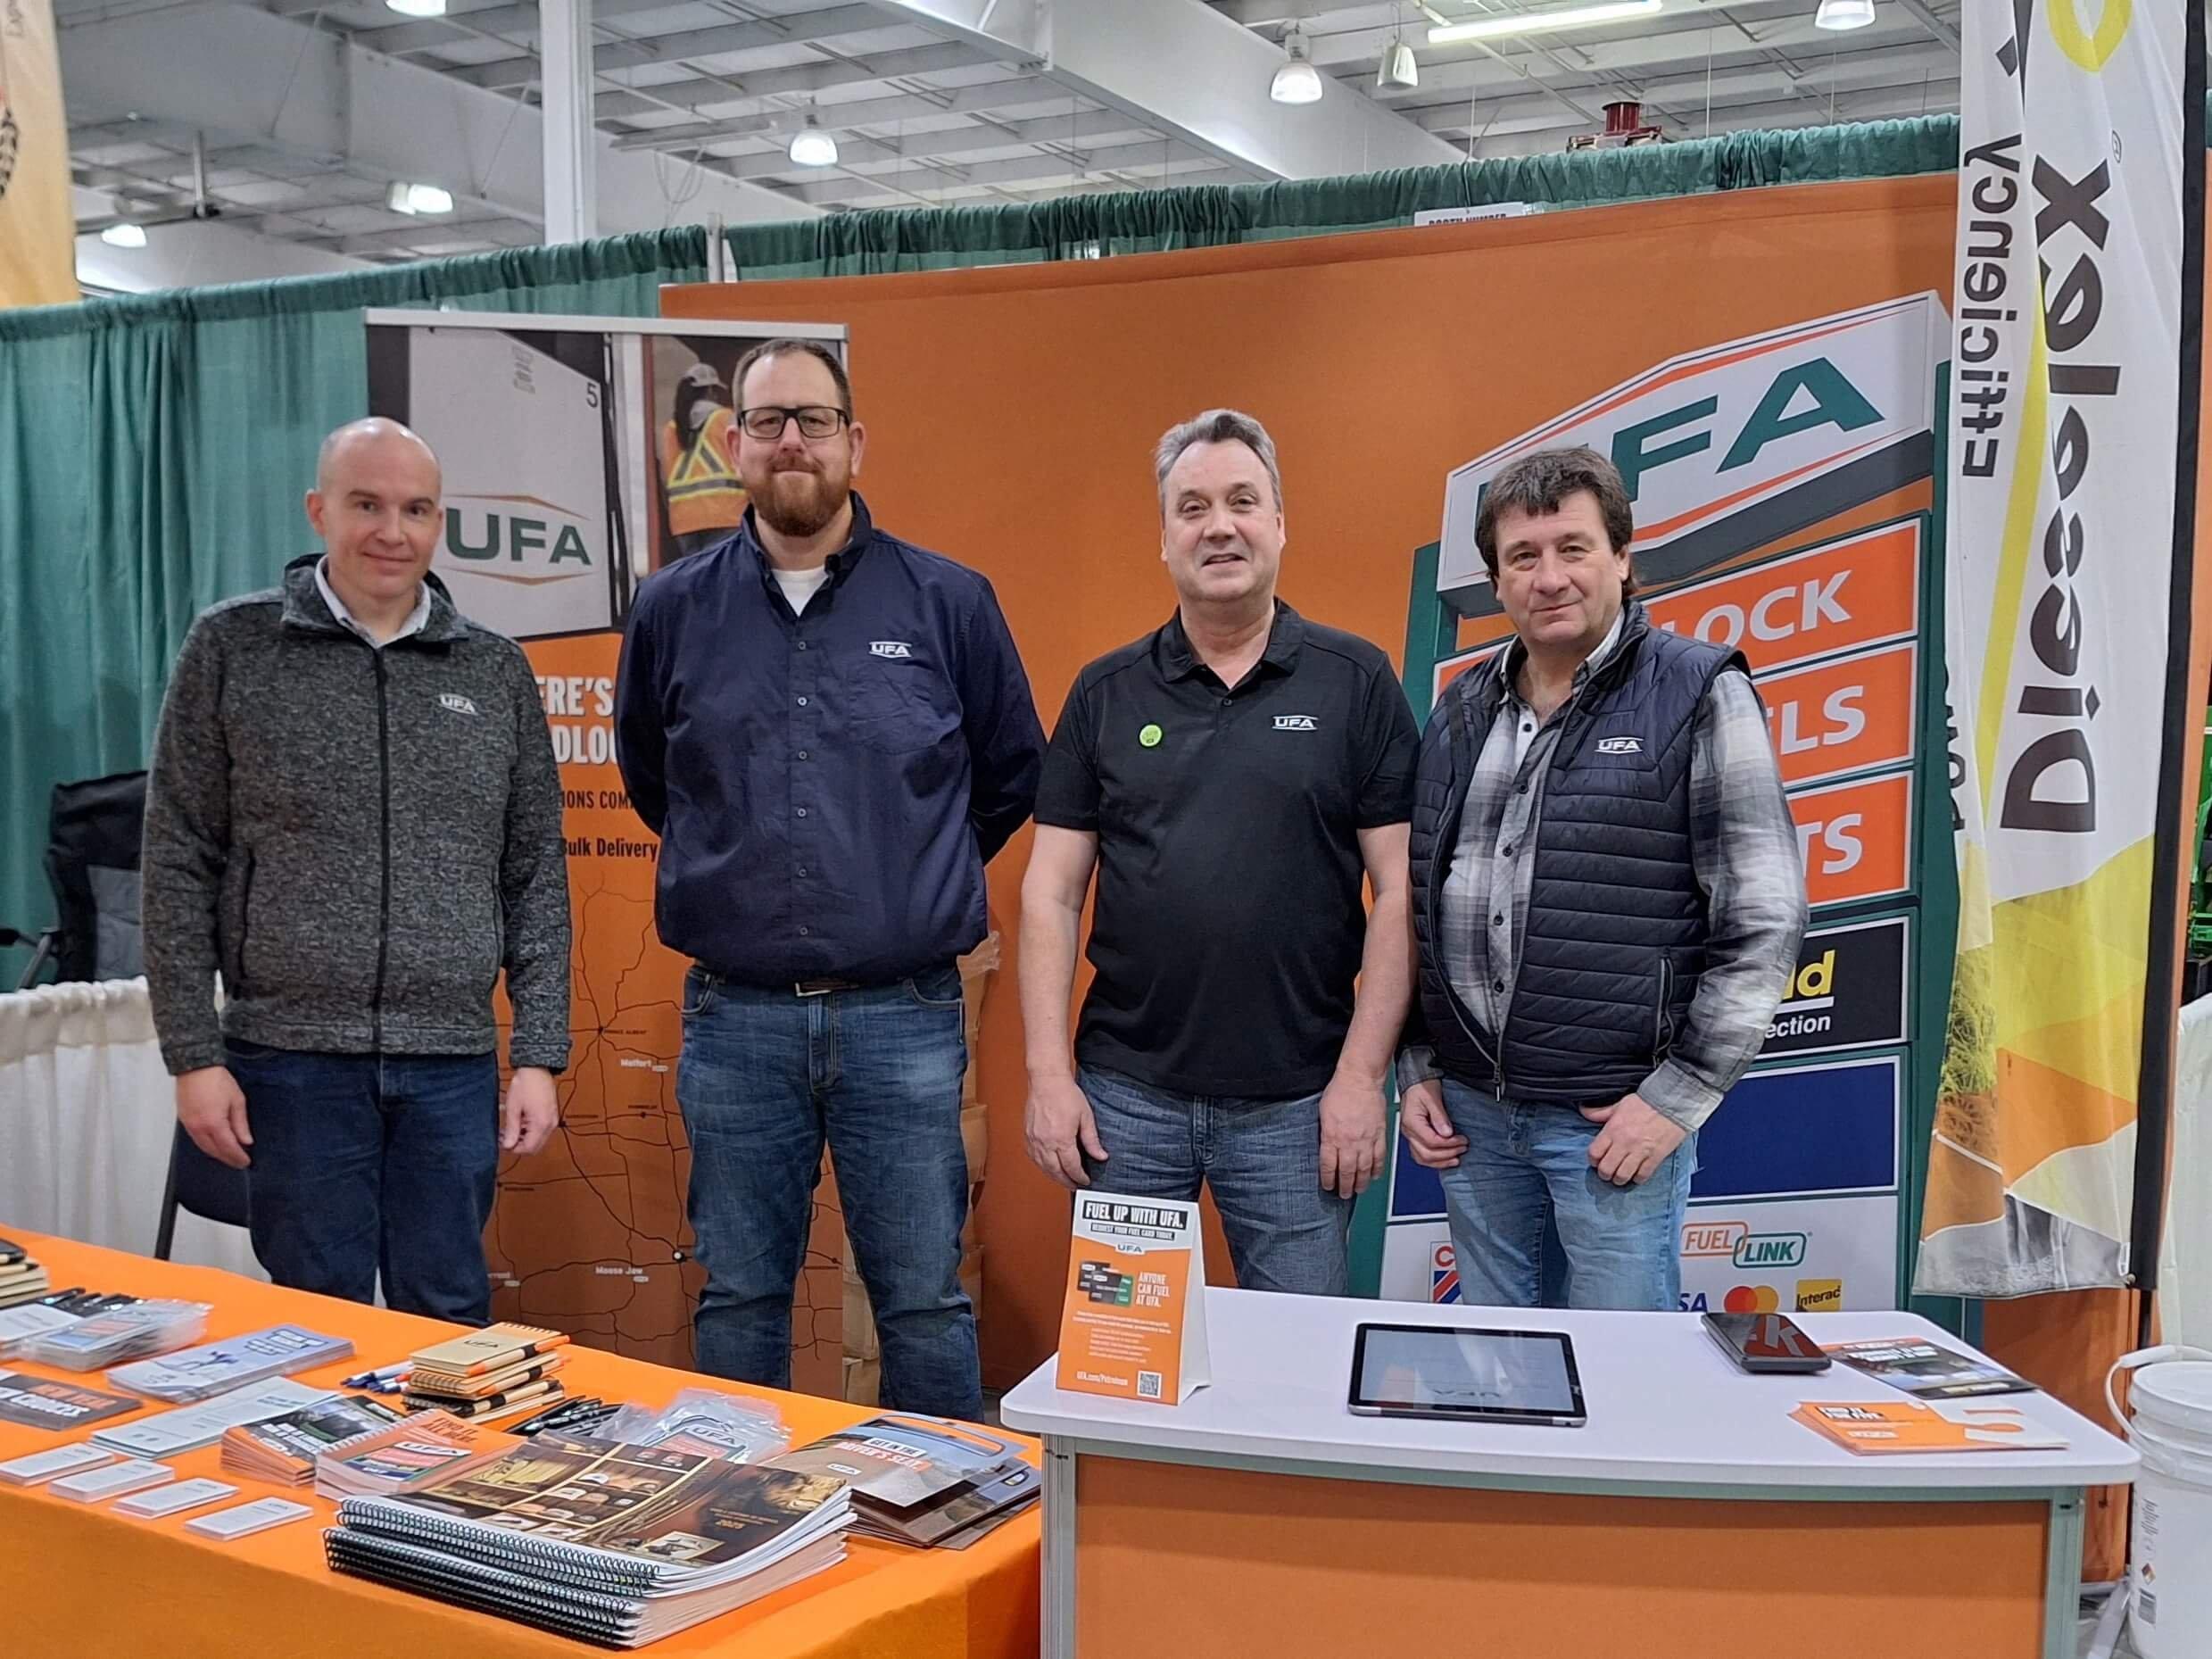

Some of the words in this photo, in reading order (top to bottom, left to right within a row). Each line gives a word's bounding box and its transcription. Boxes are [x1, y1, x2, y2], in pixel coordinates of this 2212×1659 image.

[585, 382, 599, 409] 5
[445, 506, 592, 567] UFA
[871, 643, 909, 657] UFA
[440, 694, 476, 713] UFA
[1274, 718, 1315, 728] UFA
[1766, 685, 1866, 755] LS
[551, 725, 617, 765] DLO
[1598, 740, 1641, 751] UFA
[596, 837, 659, 862] Delivery
[1085, 1202, 1111, 1220] FUEL
[1113, 1205, 1129, 1222] UP
[1130, 1207, 1158, 1225] WITH
[1159, 1210, 1183, 1228] UFA.
[1118, 1244, 1142, 1253] UFA
[1685, 1230, 1733, 1250] FUEL
[1744, 1240, 1797, 1263] LINK
[1136, 1295, 1145, 1305] AT
[1153, 1285, 1170, 1298] FUEL
[1796, 1285, 1842, 1309] Interac
[692, 1428, 736, 1445] UFA
